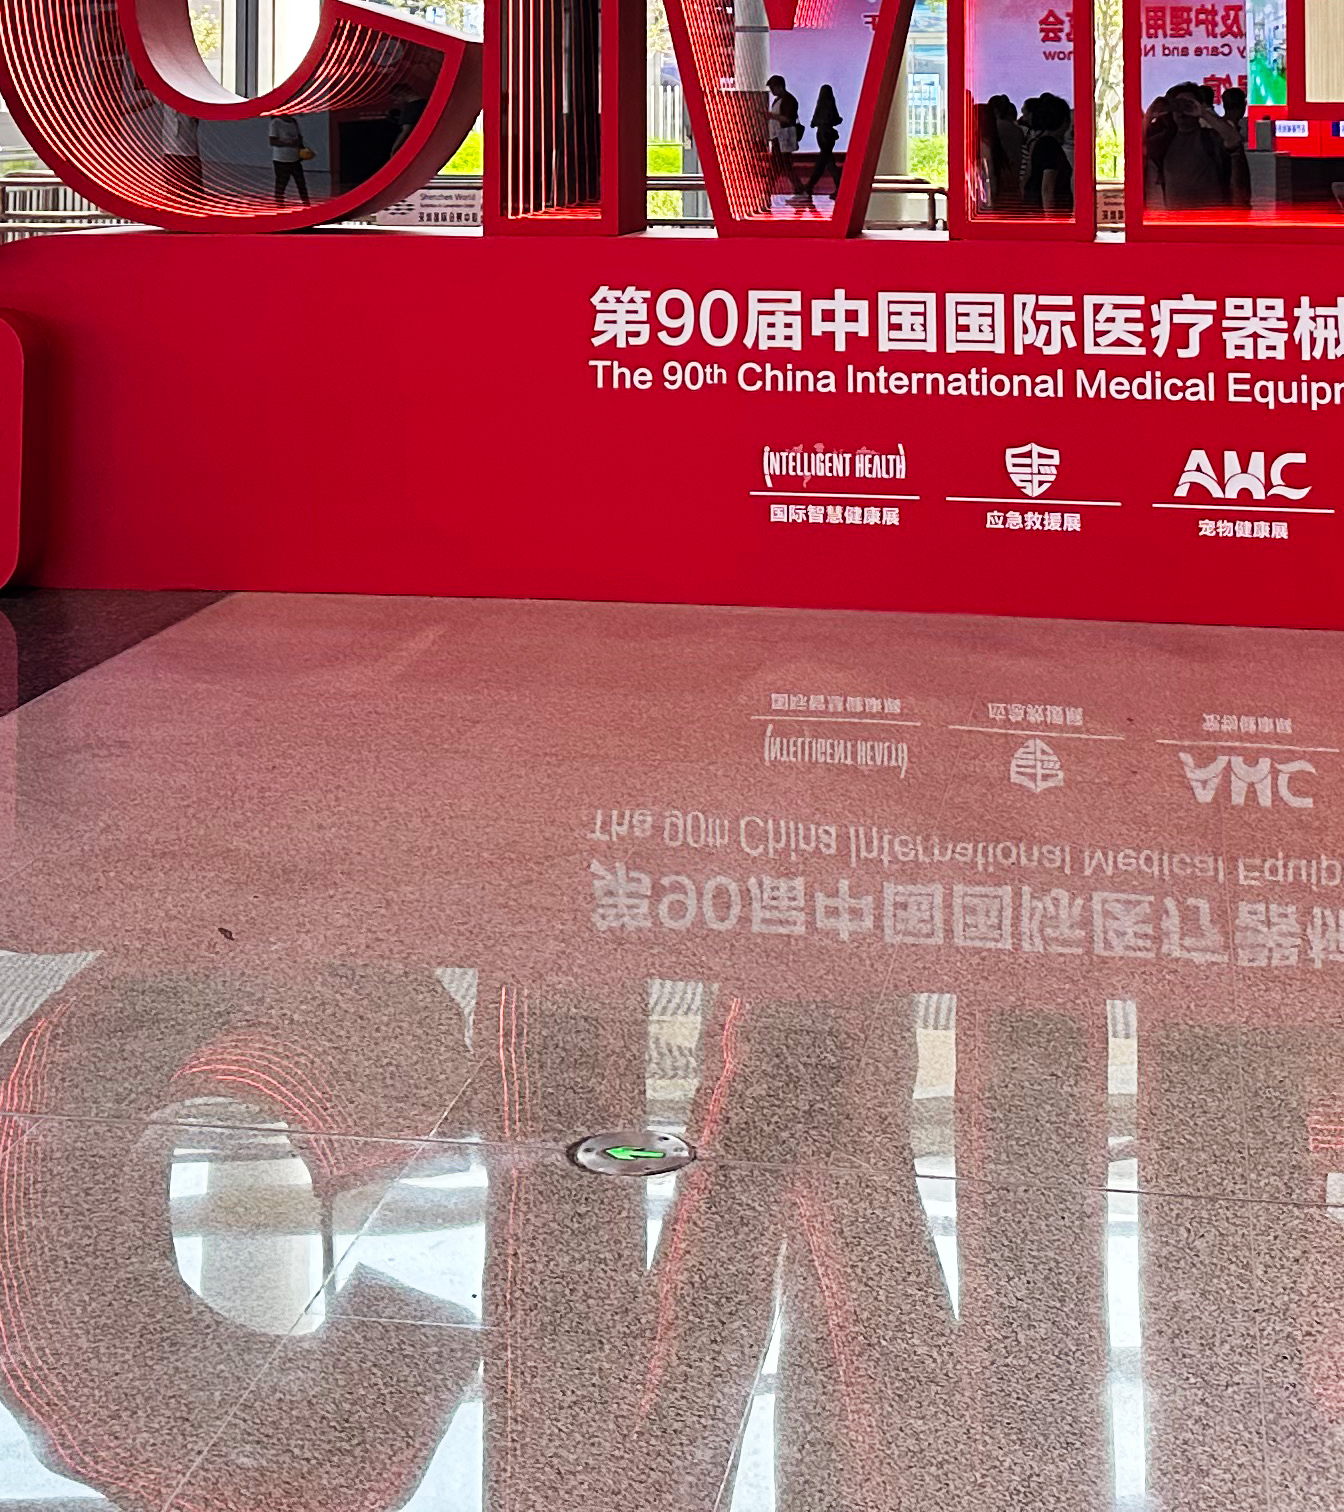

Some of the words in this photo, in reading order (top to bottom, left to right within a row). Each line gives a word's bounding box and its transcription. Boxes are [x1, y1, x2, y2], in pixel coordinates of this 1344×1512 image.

[588, 360, 653, 390] The
[662, 361, 727, 391] 90th
[737, 362, 837, 393] China
[847, 365, 1064, 398] International
[1076, 369, 1215, 402] Medical
[770, 504, 900, 526] 国际智慧健康展
[985, 510, 1081, 532] 应急救援展
[1198, 519, 1289, 540] 宠物健康展
